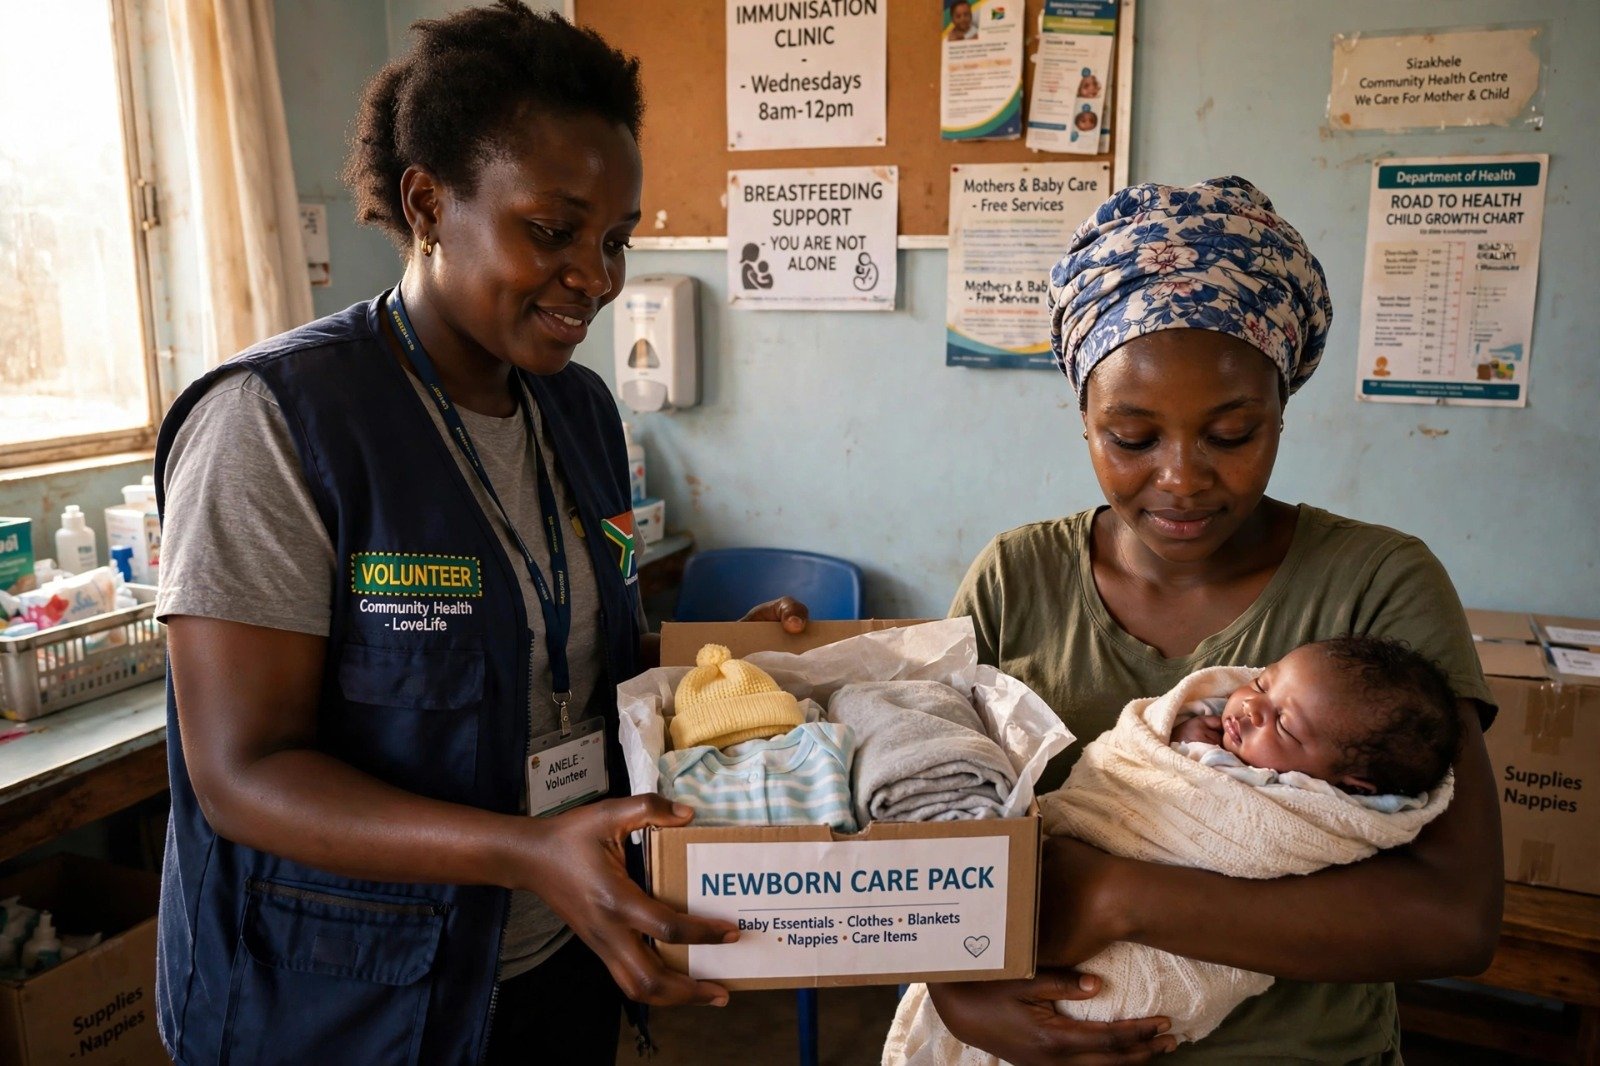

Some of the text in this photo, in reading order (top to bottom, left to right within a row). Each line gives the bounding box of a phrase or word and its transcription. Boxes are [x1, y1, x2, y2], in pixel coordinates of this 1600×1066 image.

[737, 0, 877, 24] IMMUNISATION
[775, 26, 835, 48] CLINIC
[1406, 55, 1461, 70] Sizakhele
[751, 71, 861, 94] Wednesdays
[1359, 71, 1508, 89] Community Health Centre
[1355, 88, 1509, 106] We Care For Mother & Child
[759, 100, 853, 122] 8am-12pm
[963, 177, 1098, 194] Mothers & Baby Care
[1397, 169, 1515, 185] Department of Health
[744, 182, 883, 202] BREASTFEEDING
[1391, 193, 1522, 209] ROAD TO HEALTH
[981, 198, 1008, 212] Free
[1012, 197, 1064, 212] Services
[773, 208, 852, 226] SUPPORT
[1386, 212, 1524, 225] CHILD GROWTH CHART
[770, 236, 800, 251] YOU
[803, 235, 832, 250] ARE
[836, 235, 867, 250] NOT
[788, 256, 837, 271] ALONE
[1015, 280, 1023, 292] &
[1028, 280, 1048, 292] Bab
[361, 563, 473, 587] VOLUNTEER
[360, 599, 473, 617] Community Health
[393, 617, 447, 631] LoveLife
[548, 754, 579, 775] ANELE
[545, 768, 588, 791] Volunteer
[1504, 765, 1582, 790] Supplies
[1504, 787, 1577, 813] Nappies
[701, 865, 995, 896] NEWBORN CARE PACK
[738, 917, 769, 933] Baby
[773, 916, 834, 929] Essentials
[847, 914, 894, 928] Clothes
[908, 912, 960, 926] Blankets
[788, 931, 918, 948] Nappies Care Items
[72, 987, 143, 1035] Supplies
[79, 1010, 145, 1056] Nappies
